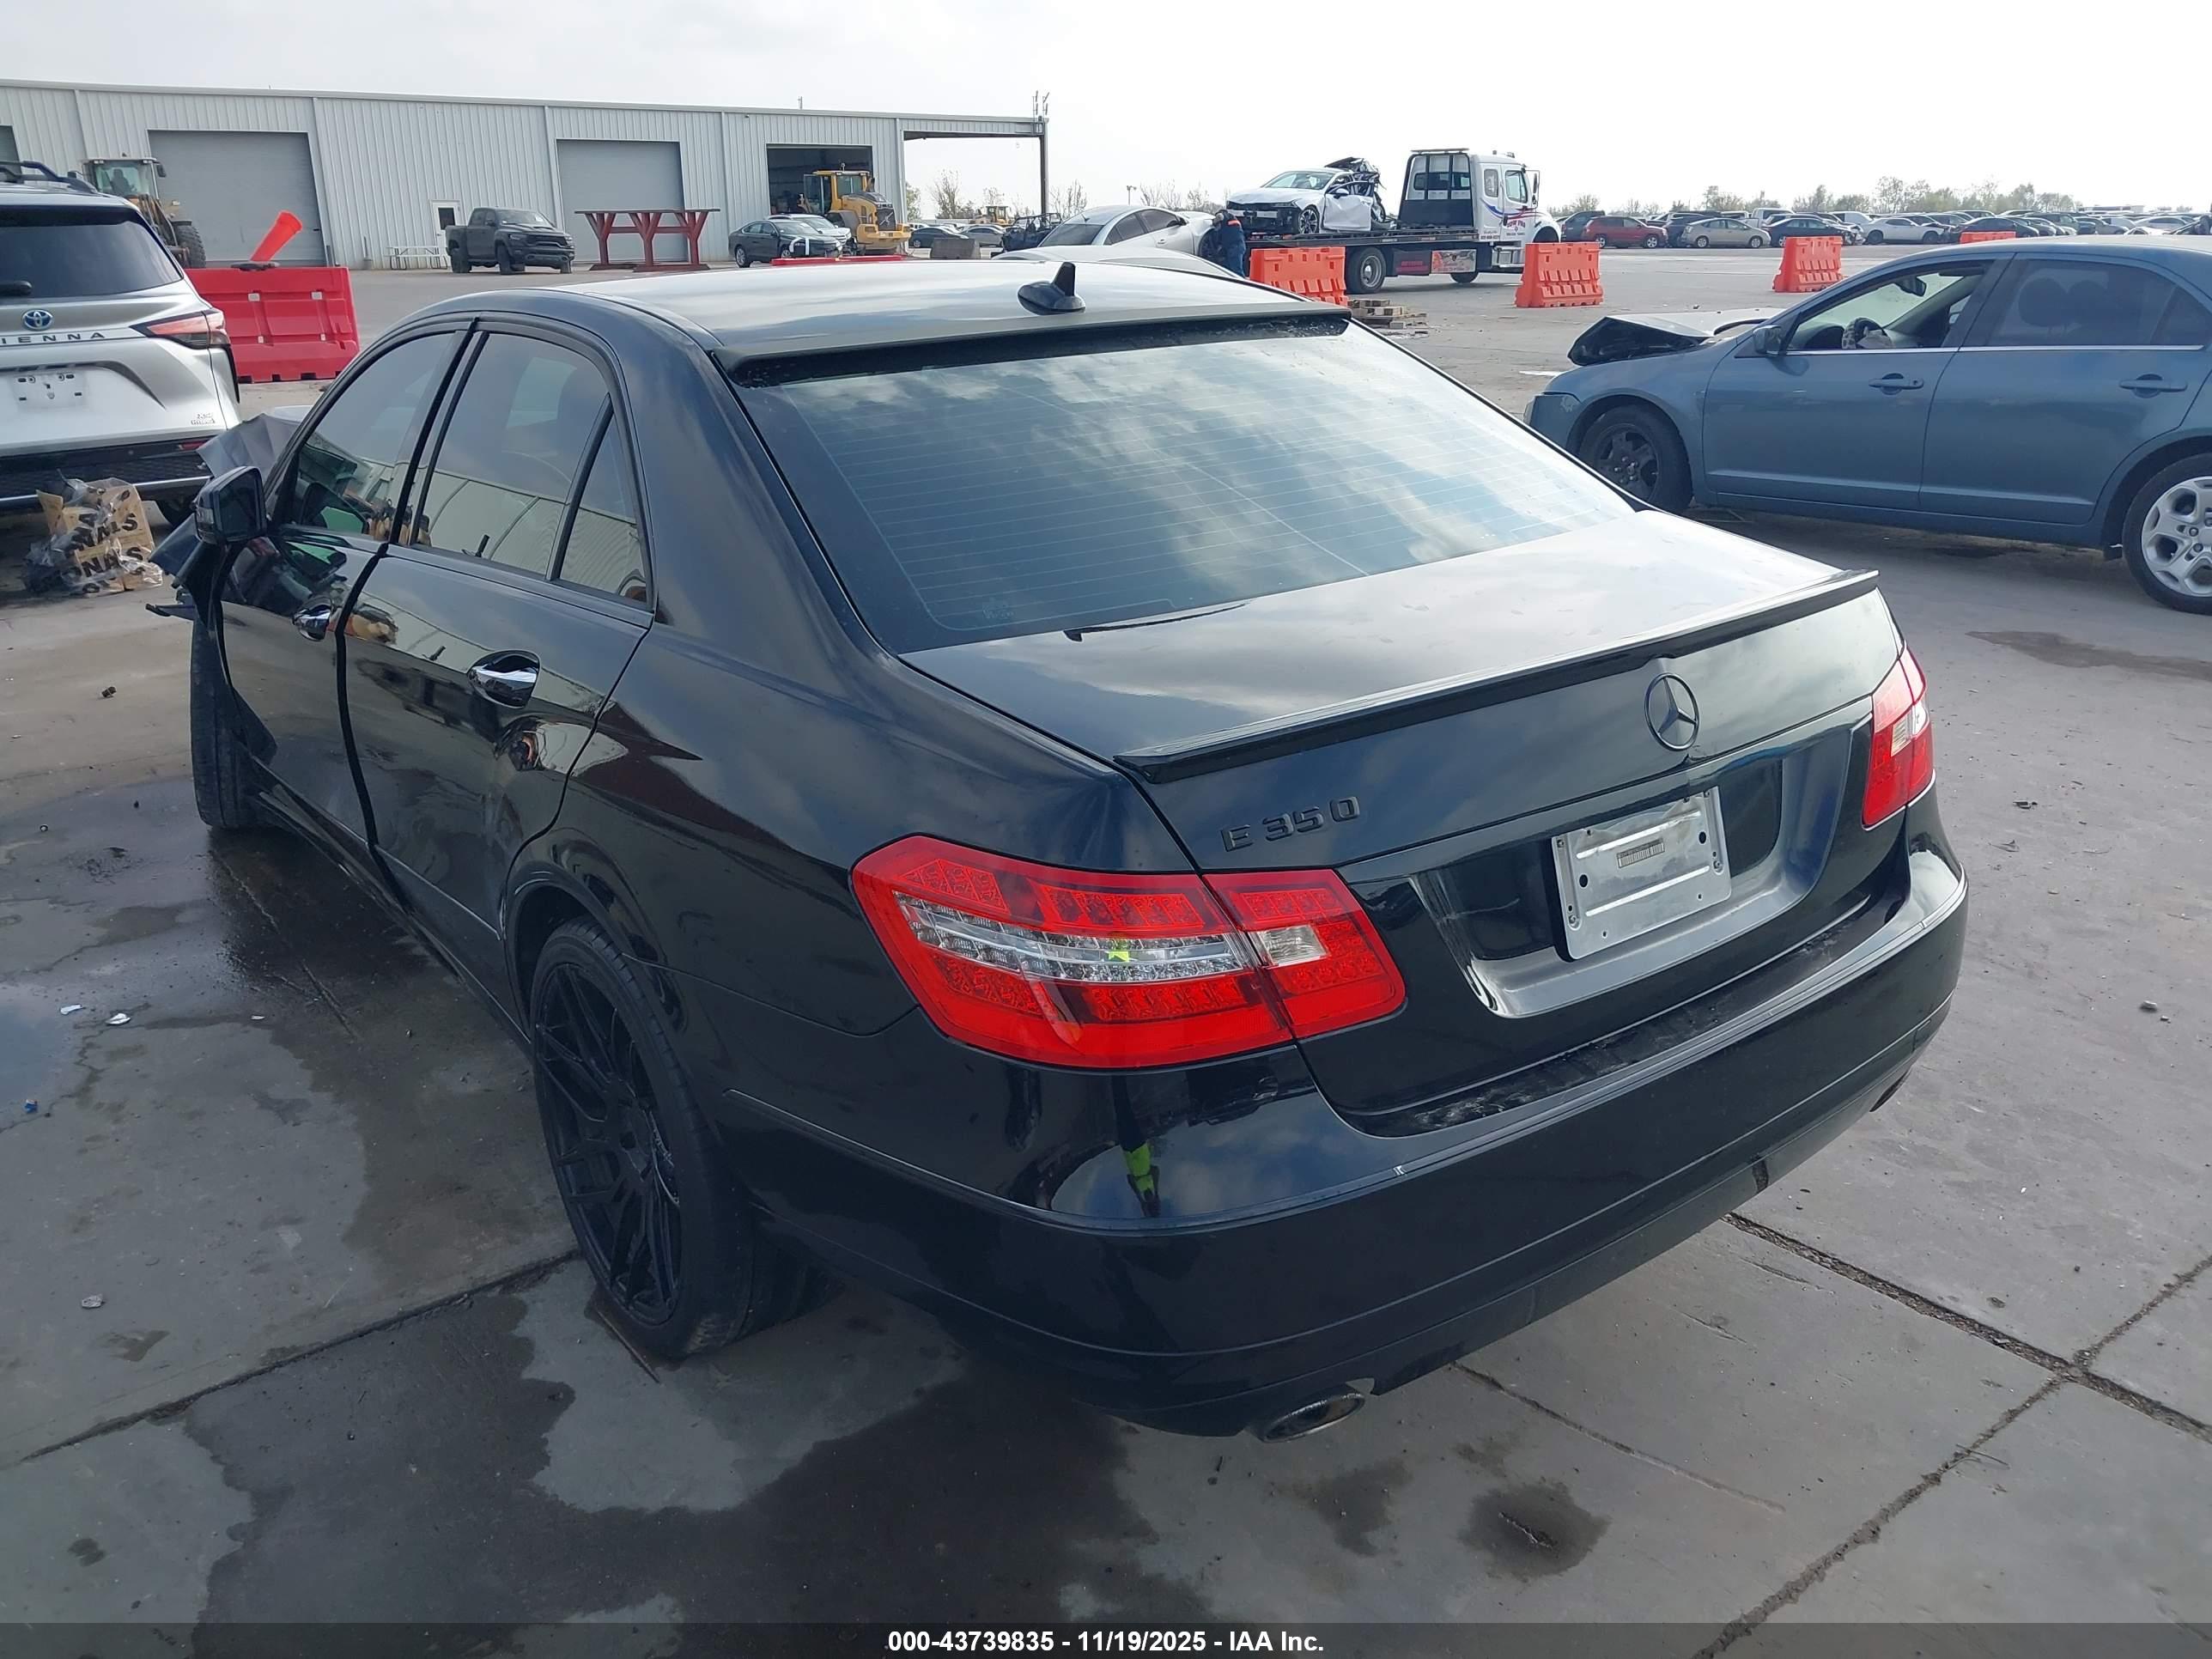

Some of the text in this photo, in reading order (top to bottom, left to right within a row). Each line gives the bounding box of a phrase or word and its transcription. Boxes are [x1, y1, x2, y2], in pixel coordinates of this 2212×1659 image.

[1, 332, 105, 344] IENNA
[1221, 797, 1360, 852] E 350
